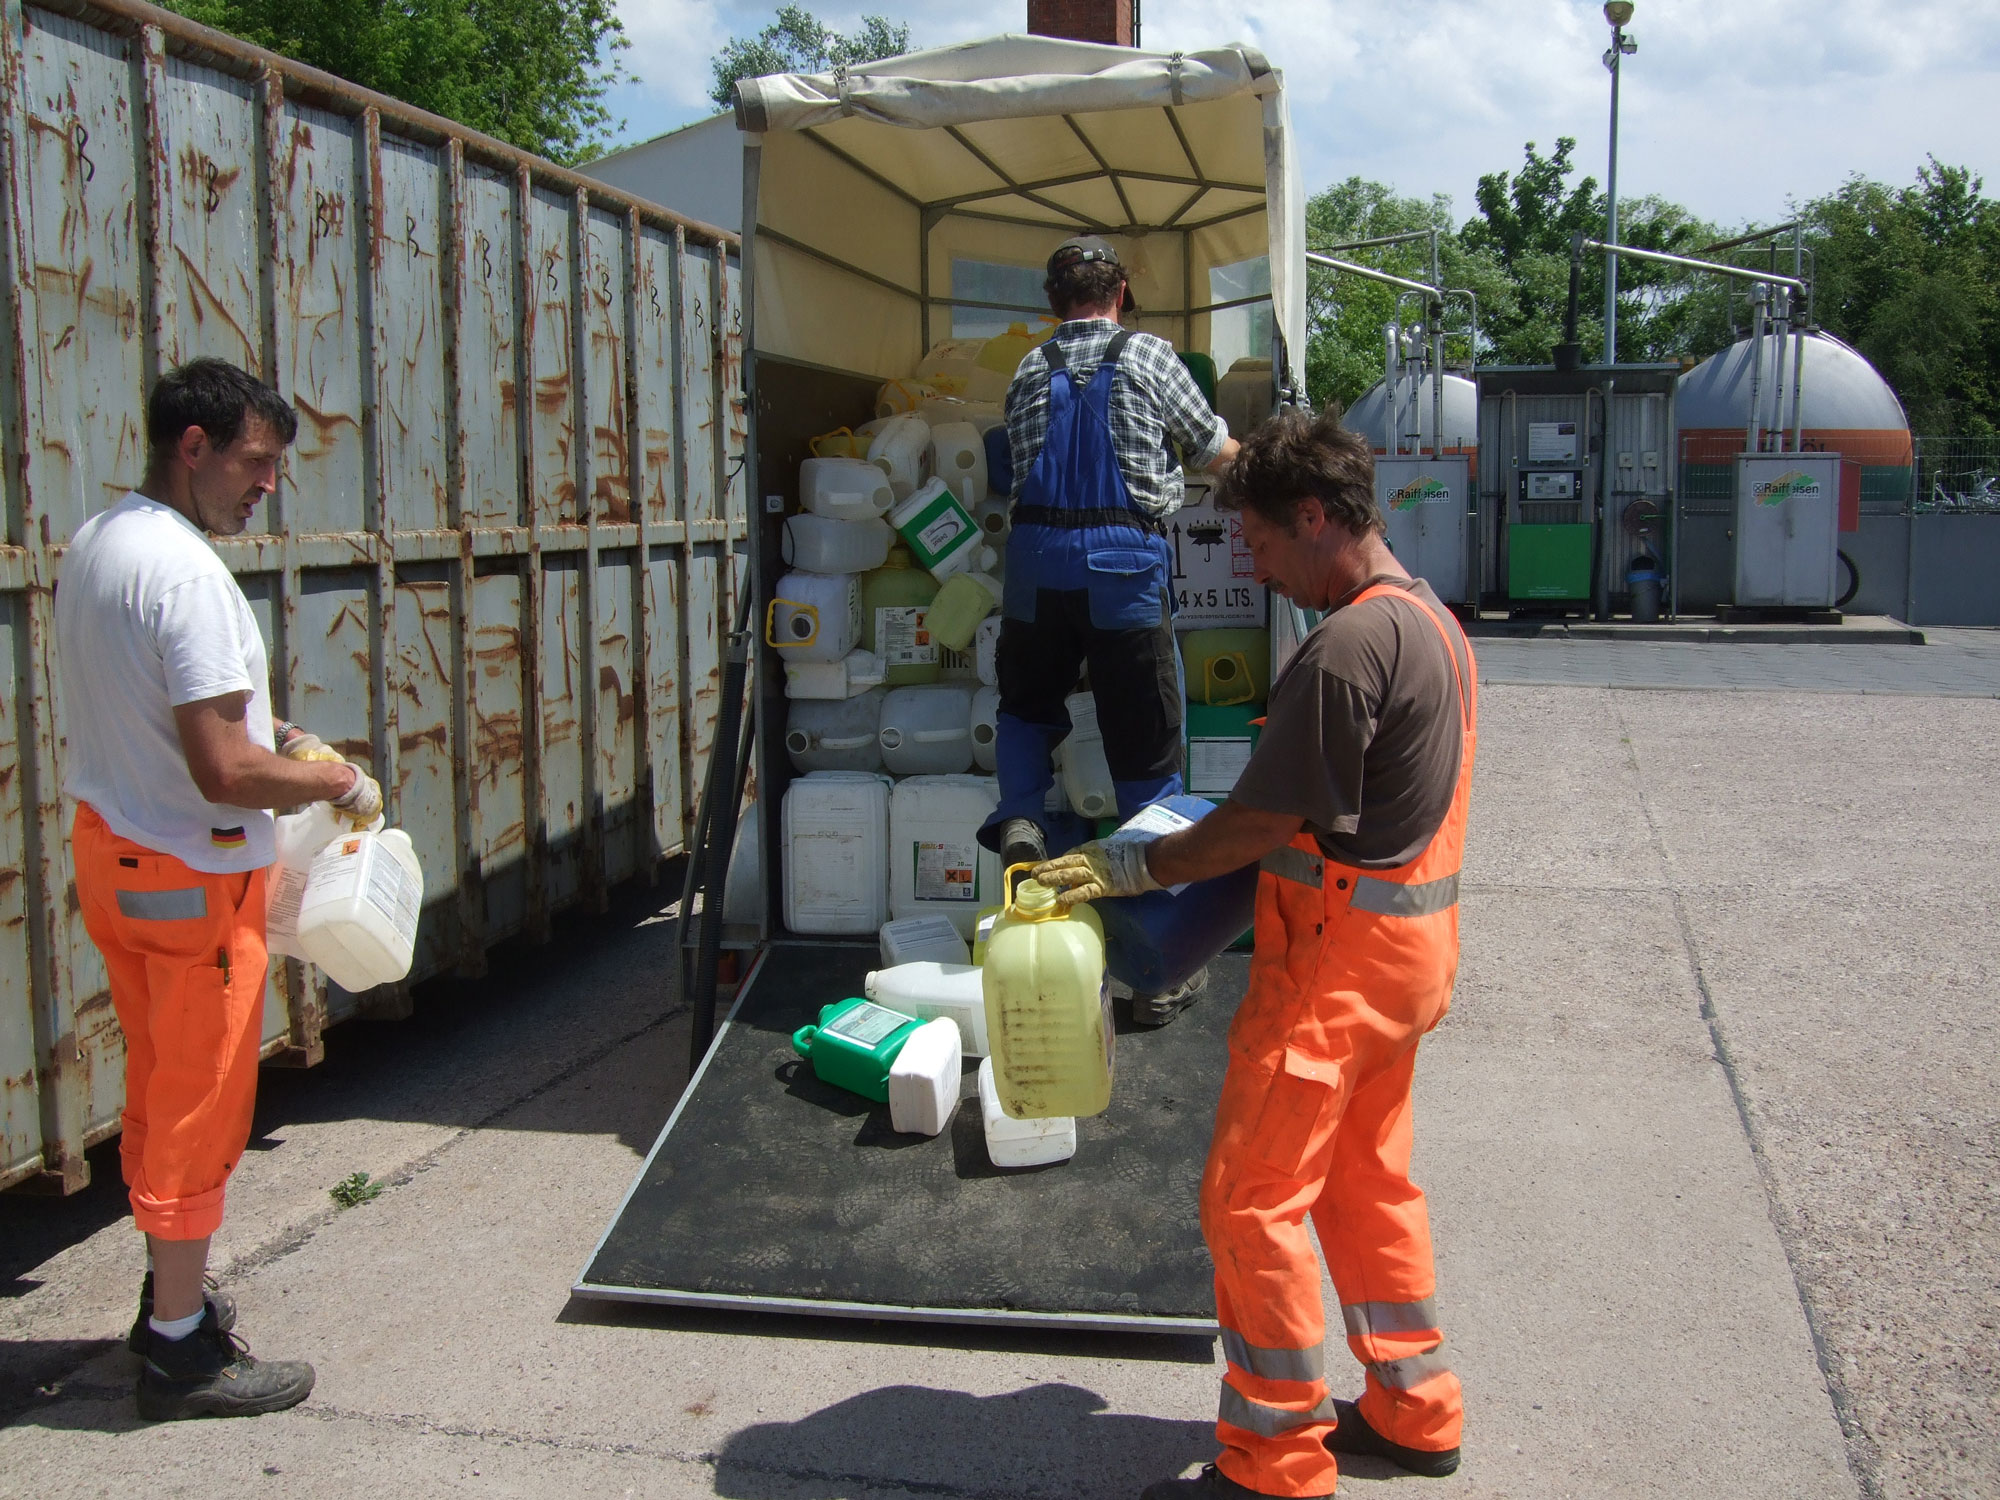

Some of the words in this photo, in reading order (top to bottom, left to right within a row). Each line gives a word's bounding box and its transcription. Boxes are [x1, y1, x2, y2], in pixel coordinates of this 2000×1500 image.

[1575, 480, 1581, 488] 2
[1764, 482, 1819, 494] Raiffeisen
[1397, 488, 1449, 499] Raiffeisen
[1179, 590, 1189, 608] 4
[1193, 593, 1204, 608] x
[1207, 589, 1218, 608] 5
[1225, 588, 1254, 608] LTS.
